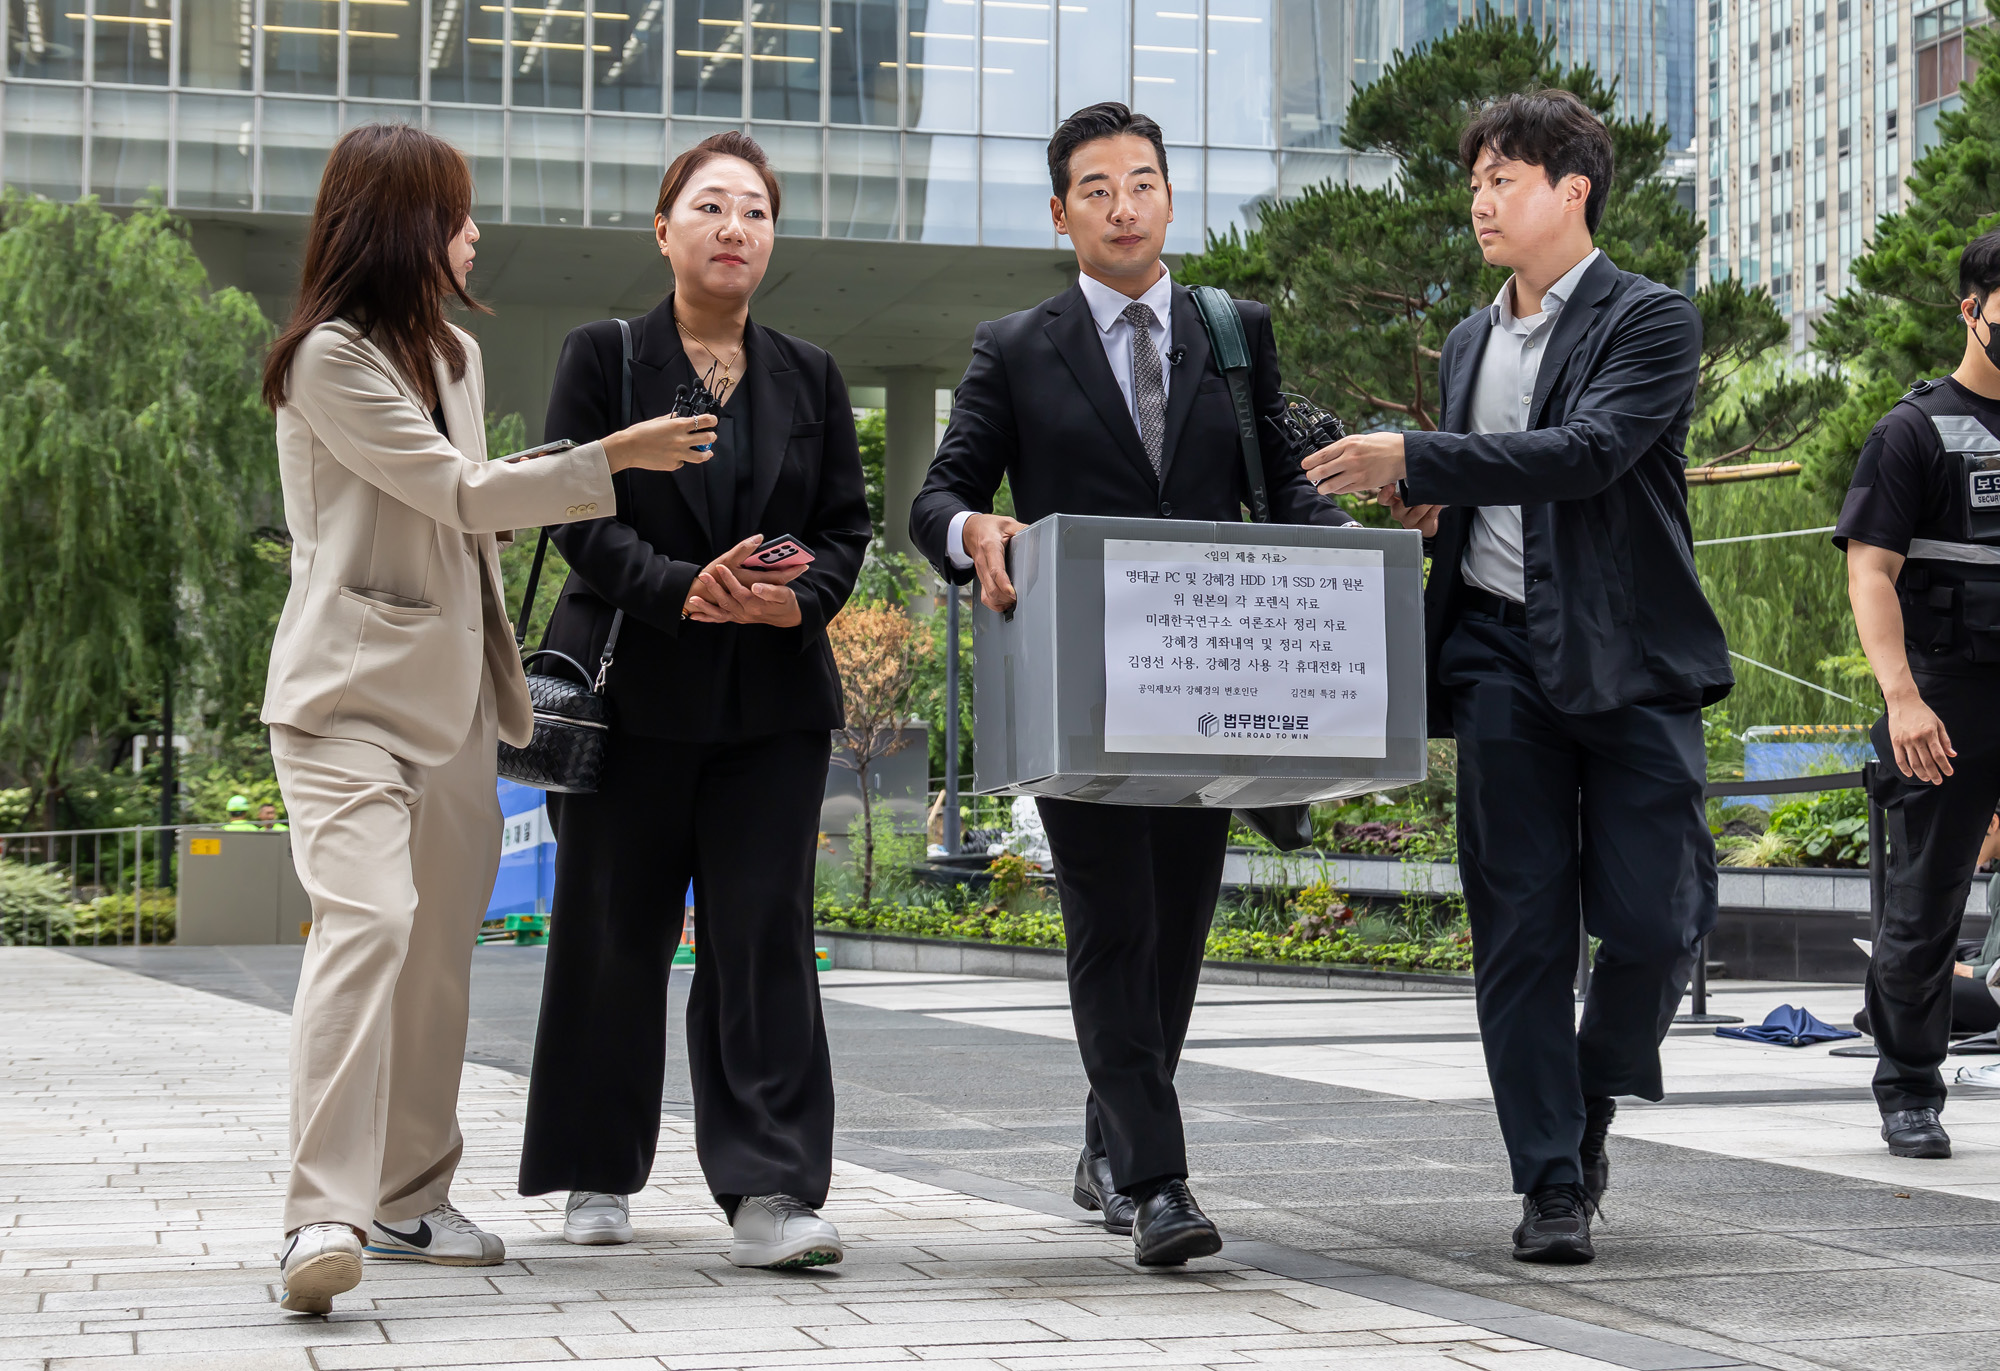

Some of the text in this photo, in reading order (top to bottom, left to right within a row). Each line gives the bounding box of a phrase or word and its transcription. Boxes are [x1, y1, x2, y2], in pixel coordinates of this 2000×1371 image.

[1204, 551, 1287, 563] <임의 제출 자료>
[1126, 570, 1364, 591] 명태균 PC 및 강혜경 HDD 1개 SSD 2개 원본
[1174, 593, 1320, 610] 위 원본의 각 포렌식 자료
[1146, 614, 1347, 632] 미래한국연구소 여론조사 정리 자료
[1162, 635, 1333, 652] 강혜경 계좌내역 및 정리 자료
[1128, 655, 1164, 669] 김영선
[1206, 657, 1240, 671] 강혜경
[1248, 658, 1271, 672] 사용
[1278, 660, 1289, 672] 각
[1296, 660, 1342, 674] 휴대전화
[1349, 662, 1365, 675] 1대
[1138, 684, 1258, 697] 공익제보자 강혜경의 변호인단
[1291, 688, 1314, 698] 김건희
[1341, 690, 1357, 699] 귀중
[1224, 714, 1309, 731] 법무법인일로
